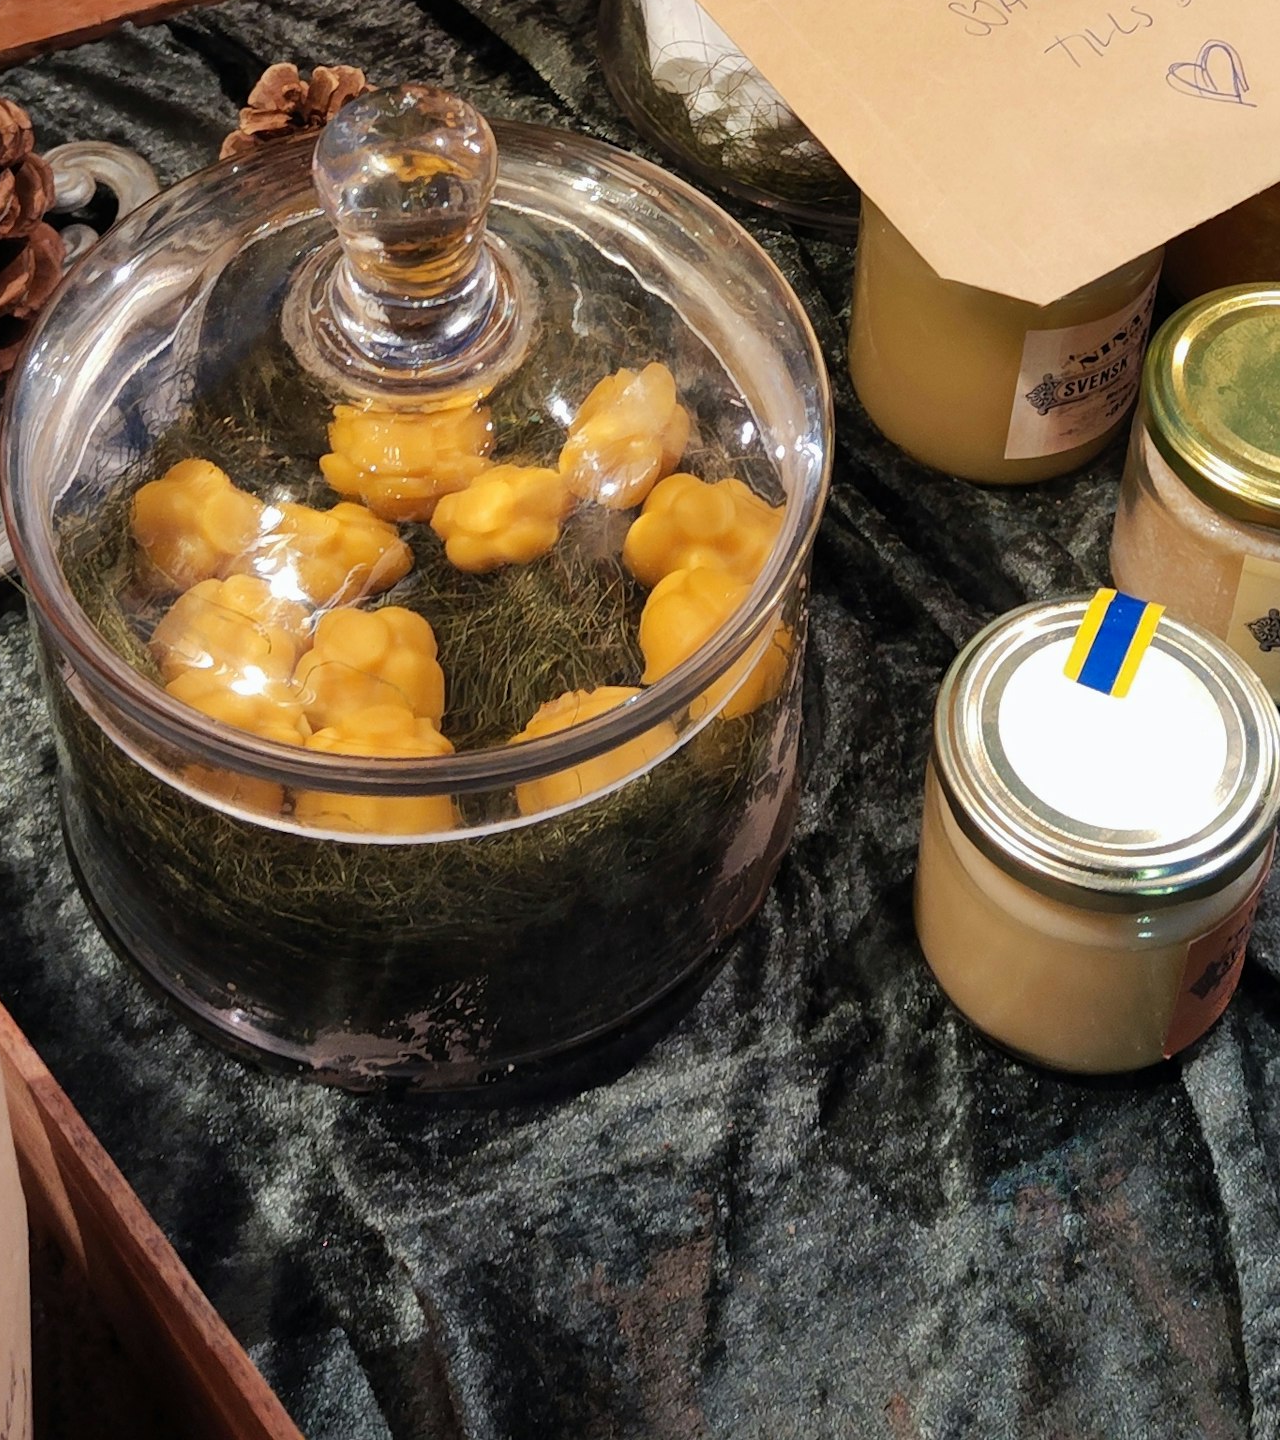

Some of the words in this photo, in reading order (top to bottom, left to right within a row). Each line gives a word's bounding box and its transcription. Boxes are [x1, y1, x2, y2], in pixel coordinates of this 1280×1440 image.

[1043, 4, 1154, 69] TILLS
[1079, 314, 1142, 371] NINA
[1063, 355, 1129, 397] SVENSK
